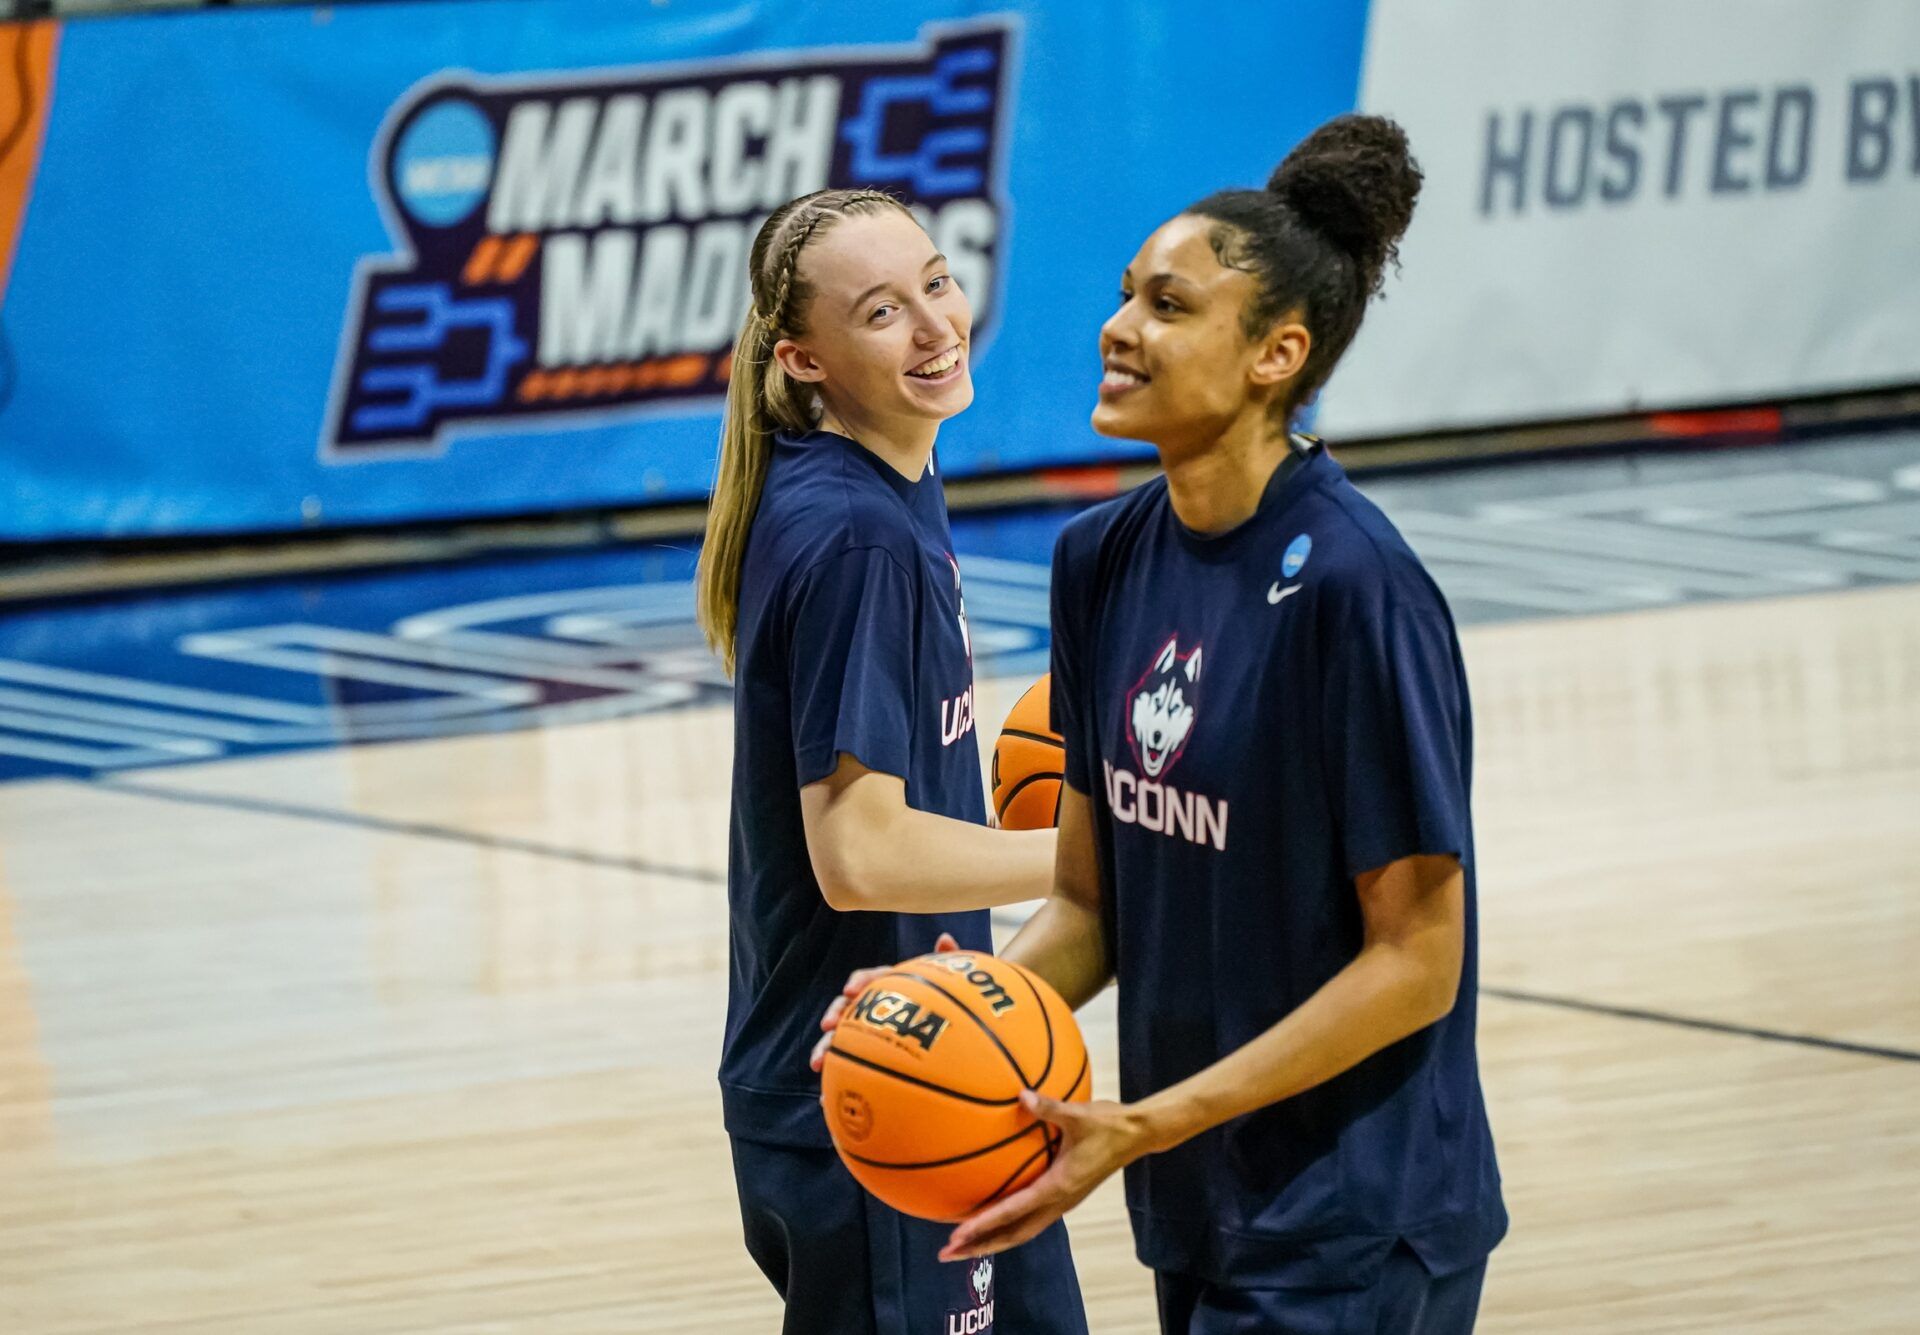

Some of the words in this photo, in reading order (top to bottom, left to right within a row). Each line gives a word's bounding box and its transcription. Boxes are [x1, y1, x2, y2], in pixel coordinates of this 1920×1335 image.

[485, 74, 842, 236] MARCH
[1479, 85, 1815, 216] HOSTED
[537, 199, 997, 367] MADS
[848, 989, 948, 1051] NCAA
